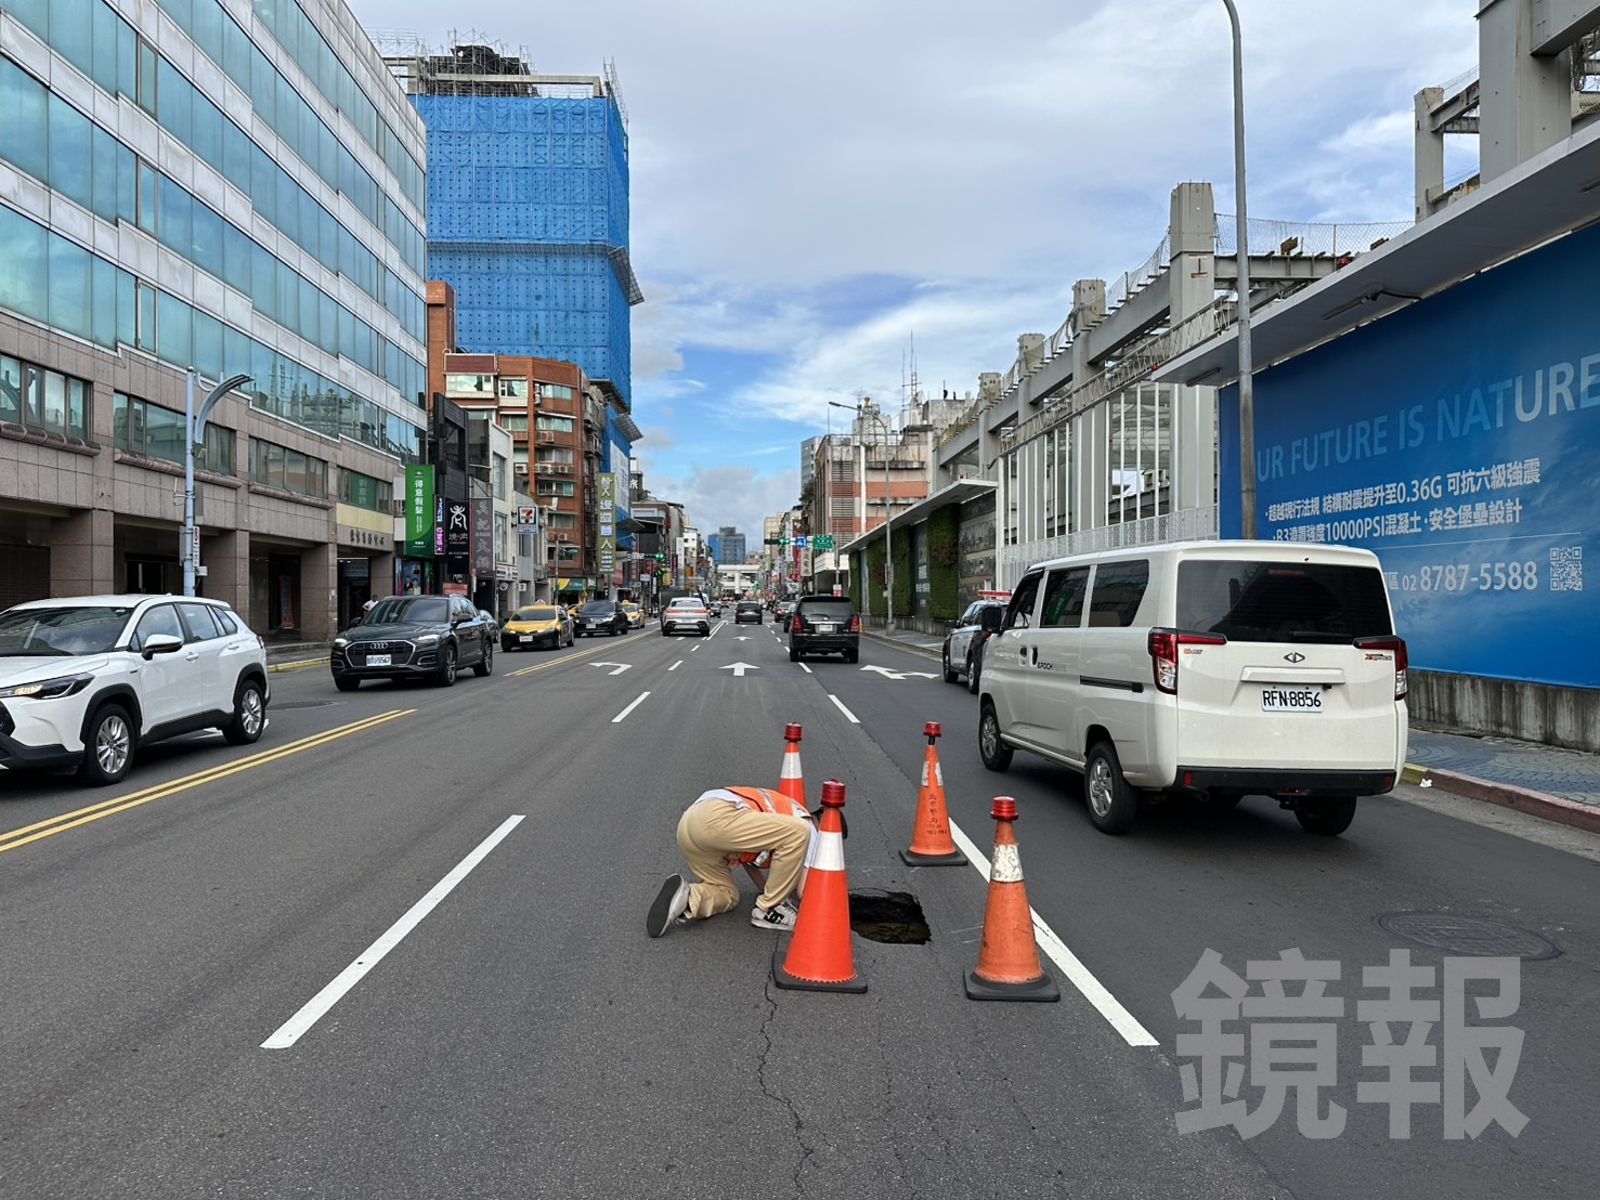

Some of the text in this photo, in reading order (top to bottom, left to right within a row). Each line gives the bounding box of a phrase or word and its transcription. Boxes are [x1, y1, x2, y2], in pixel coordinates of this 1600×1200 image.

[1256, 354, 1600, 482] UR FUTURE IS NATURE
[1447, 458, 1541, 496] 可抗六級強震
[1402, 574, 1417, 591] 02
[1420, 561, 1538, 592] 8787-5588
